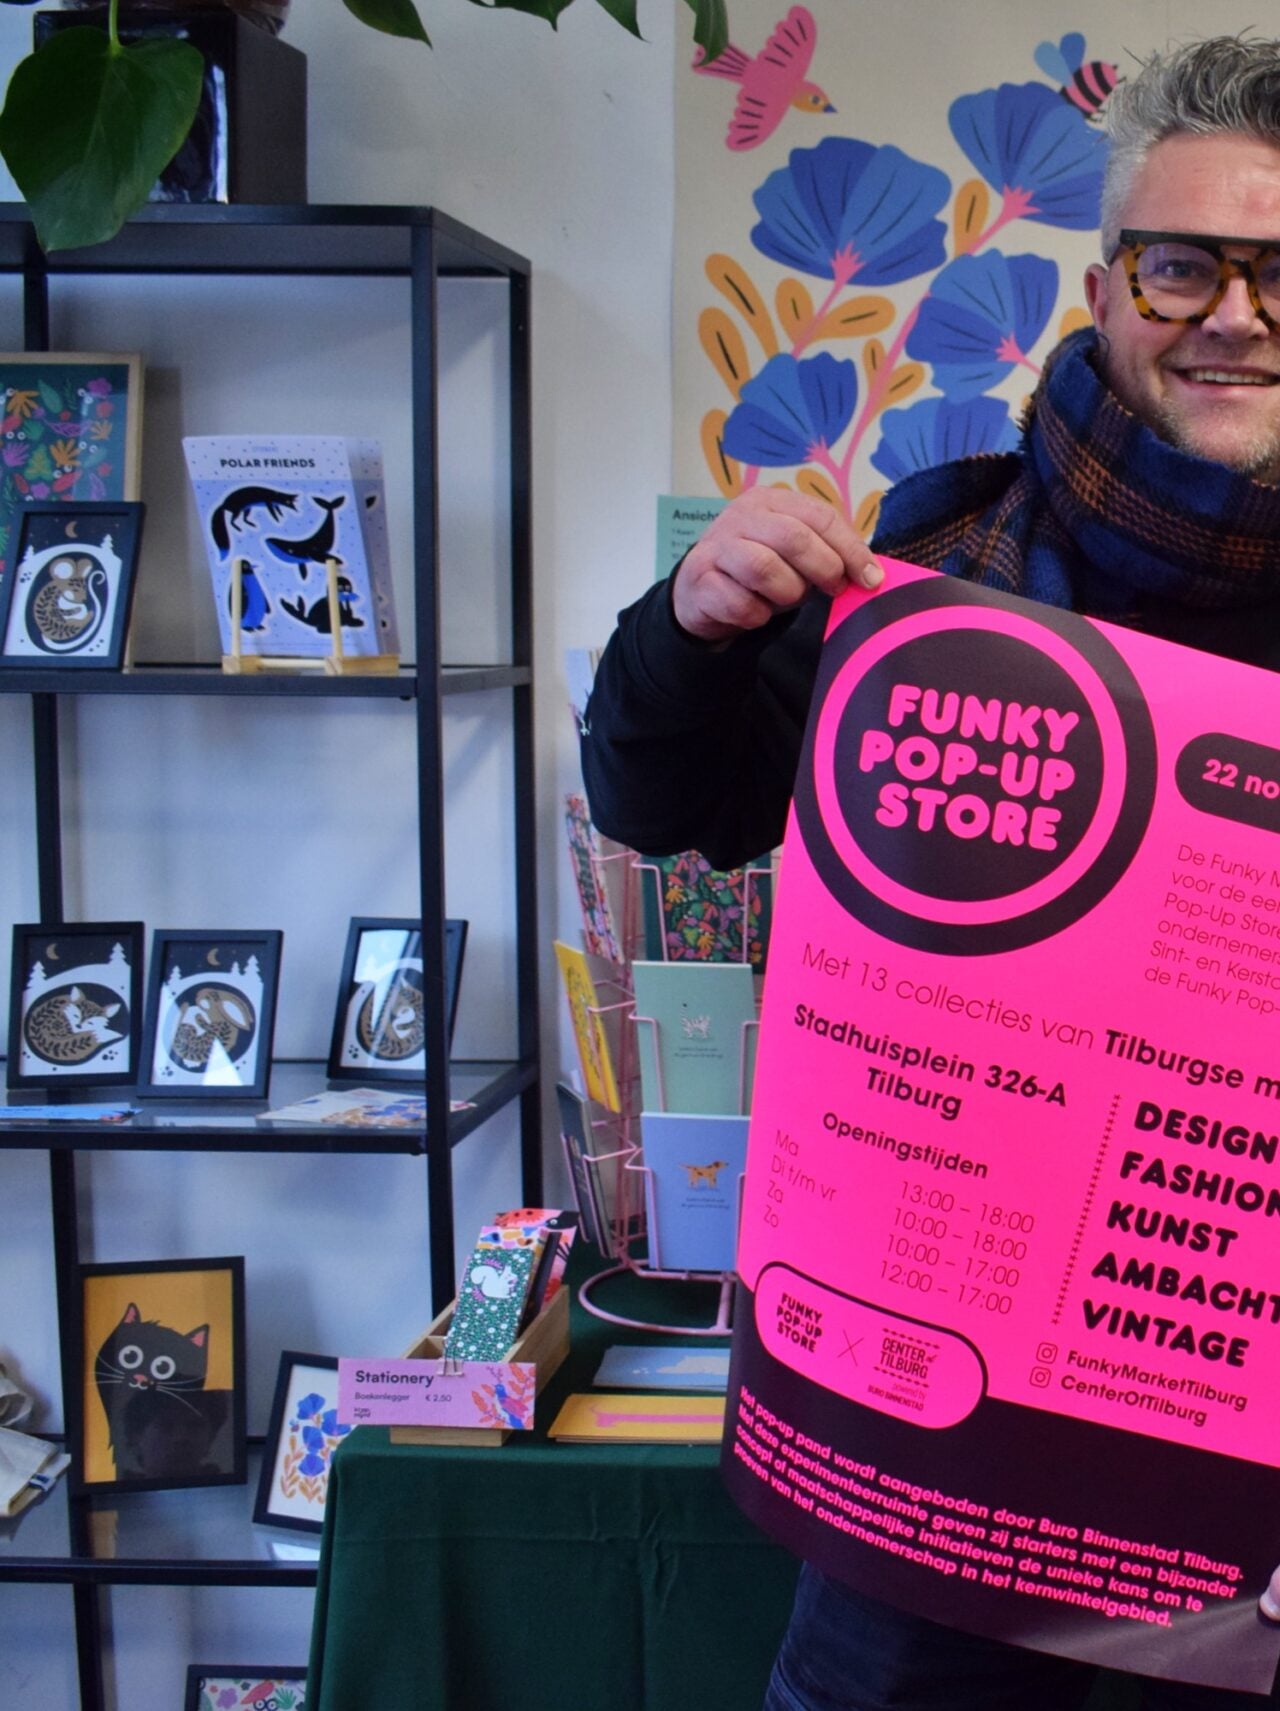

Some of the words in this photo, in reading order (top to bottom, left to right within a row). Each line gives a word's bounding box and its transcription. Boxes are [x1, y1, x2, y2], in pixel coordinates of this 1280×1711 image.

[221, 459, 260, 468] POLAR
[264, 459, 316, 468] FRIENDS
[888, 684, 1079, 752] FUNKY
[859, 729, 1075, 801] POP-UP
[1201, 758, 1238, 788] 22
[876, 782, 1062, 851] STORE
[1172, 871, 1215, 893] voor
[1220, 884, 1245, 903] de
[1177, 845, 1205, 866] De
[1210, 853, 1266, 884] Funky
[1164, 892, 1235, 927] Pop-Up
[1151, 940, 1191, 963] Sint-
[1196, 954, 1220, 973] en
[1145, 966, 1171, 985] de
[1176, 973, 1232, 1005] Funky
[802, 943, 850, 980] Met
[860, 962, 888, 992] 13
[896, 980, 1032, 1033] collecties
[1042, 1018, 1093, 1050] van
[1105, 1028, 1244, 1088] Tilburgse
[795, 1003, 975, 1082] Stadhuisplein
[984, 1065, 1066, 1108] 326-A
[867, 1067, 962, 1121] Tilburg
[775, 1130, 799, 1156] Ma
[823, 1112, 989, 1179] Openingstijden
[1134, 1101, 1279, 1164] DESIGN
[767, 1180, 784, 1204] Za
[771, 1155, 786, 1174] Di
[788, 1166, 815, 1192] t/m
[821, 1183, 837, 1201] vr
[763, 1205, 780, 1228] Zo
[893, 1207, 947, 1239] 10:00
[973, 1230, 1027, 1261] 18:00
[901, 1181, 954, 1212] 13:00
[980, 1204, 1035, 1234] 18:00
[1106, 1200, 1238, 1265] KUNST
[886, 1234, 940, 1265] 10:00
[965, 1257, 1020, 1287] 17:00
[782, 1292, 822, 1324] FUNKY
[880, 1260, 933, 1293] 12:00
[958, 1284, 1012, 1315] 17:00
[777, 1305, 822, 1339] POP-UP
[778, 1321, 816, 1353] STORE
[1083, 1299, 1250, 1367] VINTAGE
[880, 1351, 928, 1379] TILBURG
[882, 1337, 925, 1363] CENTER
[355, 1370, 434, 1387] Stationery
[355, 1392, 410, 1402] Boekenlegger
[1061, 1374, 1207, 1427] CenterOfTilburg
[1066, 1350, 1248, 1412] FunkyMarketTilburg
[739, 1403, 754, 1428] Met
[755, 1423, 779, 1448] deze
[781, 1443, 928, 1522] experimenteerruimte
[931, 1514, 986, 1539] geven
[990, 1529, 1010, 1547] zij
[1013, 1536, 1078, 1561] starters
[1082, 1552, 1117, 1570] met
[1120, 1560, 1152, 1578] een
[1157, 1567, 1237, 1599] bijzonder
[741, 1385, 755, 1409] Het
[755, 1404, 794, 1438] pop-up
[795, 1432, 831, 1459] pand
[834, 1451, 876, 1480] wordt
[879, 1474, 989, 1519] aangeboden
[994, 1508, 1036, 1530] door
[1039, 1518, 1078, 1539] Buro
[1082, 1528, 1180, 1564] Binnenstad
[1183, 1551, 1244, 1581] Tilburg.
[734, 1442, 769, 1482] proeven
[771, 1475, 791, 1498] van
[794, 1489, 815, 1512] het
[816, 1506, 957, 1575] ondernemerschap
[962, 1563, 978, 1580] in
[982, 1568, 1011, 1588] het
[1015, 1577, 1173, 1627] kernwinkelgebied.
[736, 1424, 773, 1464] concept
[774, 1459, 786, 1473] of
[787, 1466, 915, 1538] maatschappelijke
[919, 1528, 1013, 1568] initiatieven
[1019, 1558, 1041, 1574] de
[1047, 1564, 1104, 1588] unieke
[1109, 1577, 1149, 1599] kans
[1154, 1589, 1181, 1607] om
[1186, 1595, 1203, 1613] te
